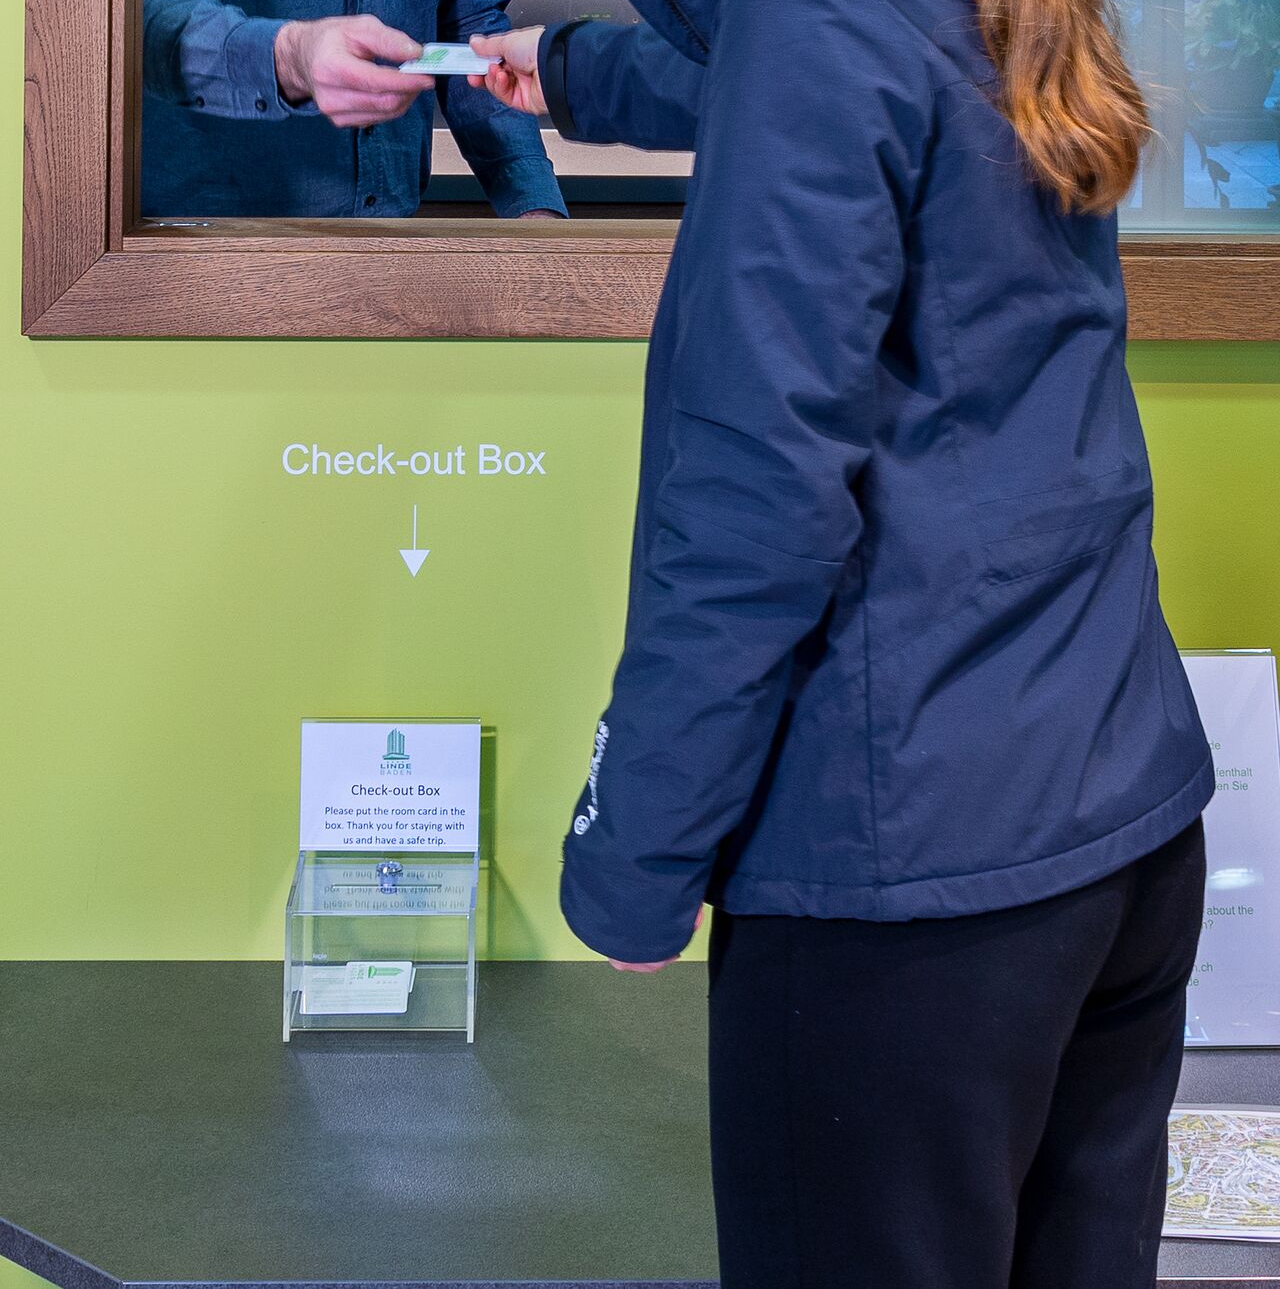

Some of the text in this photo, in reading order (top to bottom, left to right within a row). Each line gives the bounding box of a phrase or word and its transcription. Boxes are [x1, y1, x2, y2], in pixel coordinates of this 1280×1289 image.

[282, 443, 546, 475] Check-out Box
[351, 784, 440, 796] Check-out Box
[1232, 781, 1248, 790] Sie
[325, 807, 354, 815] Please
[356, 808, 371, 817] put
[374, 807, 389, 815] the
[418, 807, 437, 816] card
[440, 807, 448, 816] in
[451, 807, 465, 816] the
[325, 821, 465, 832] box. Thank you for staying with
[356, 836, 372, 844] and
[375, 836, 396, 845] have
[407, 836, 425, 845] safe
[427, 837, 446, 846] trip.
[1206, 906, 1253, 915] about the
